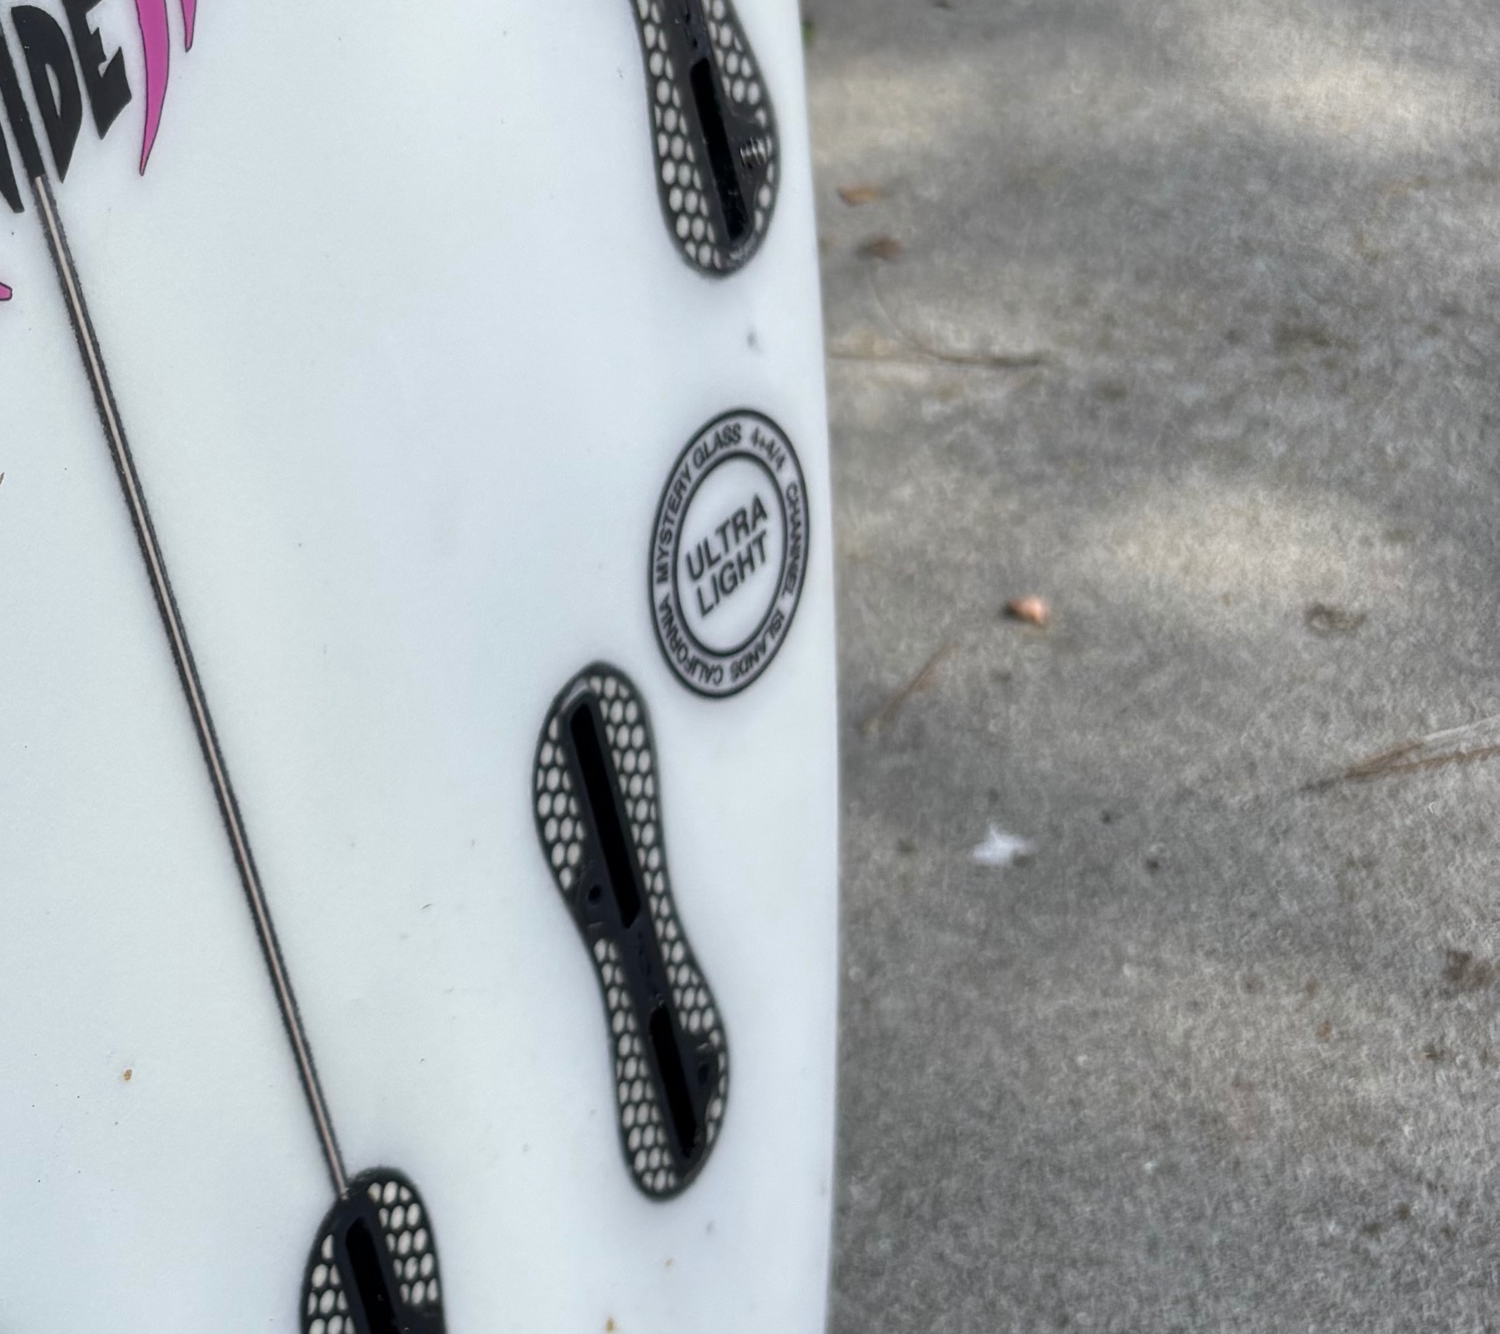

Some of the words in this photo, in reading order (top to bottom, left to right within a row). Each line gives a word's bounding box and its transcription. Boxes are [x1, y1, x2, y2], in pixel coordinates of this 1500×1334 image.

[656, 466, 692, 585] MYSTERY
[692, 423, 741, 466] GLASS
[685, 493, 768, 582] ULTRA
[783, 482, 803, 596] CHANNEL
[695, 530, 768, 617] LIGHT
[658, 594, 724, 685] CALIFORNIA
[730, 609, 785, 682] ISLANDS
